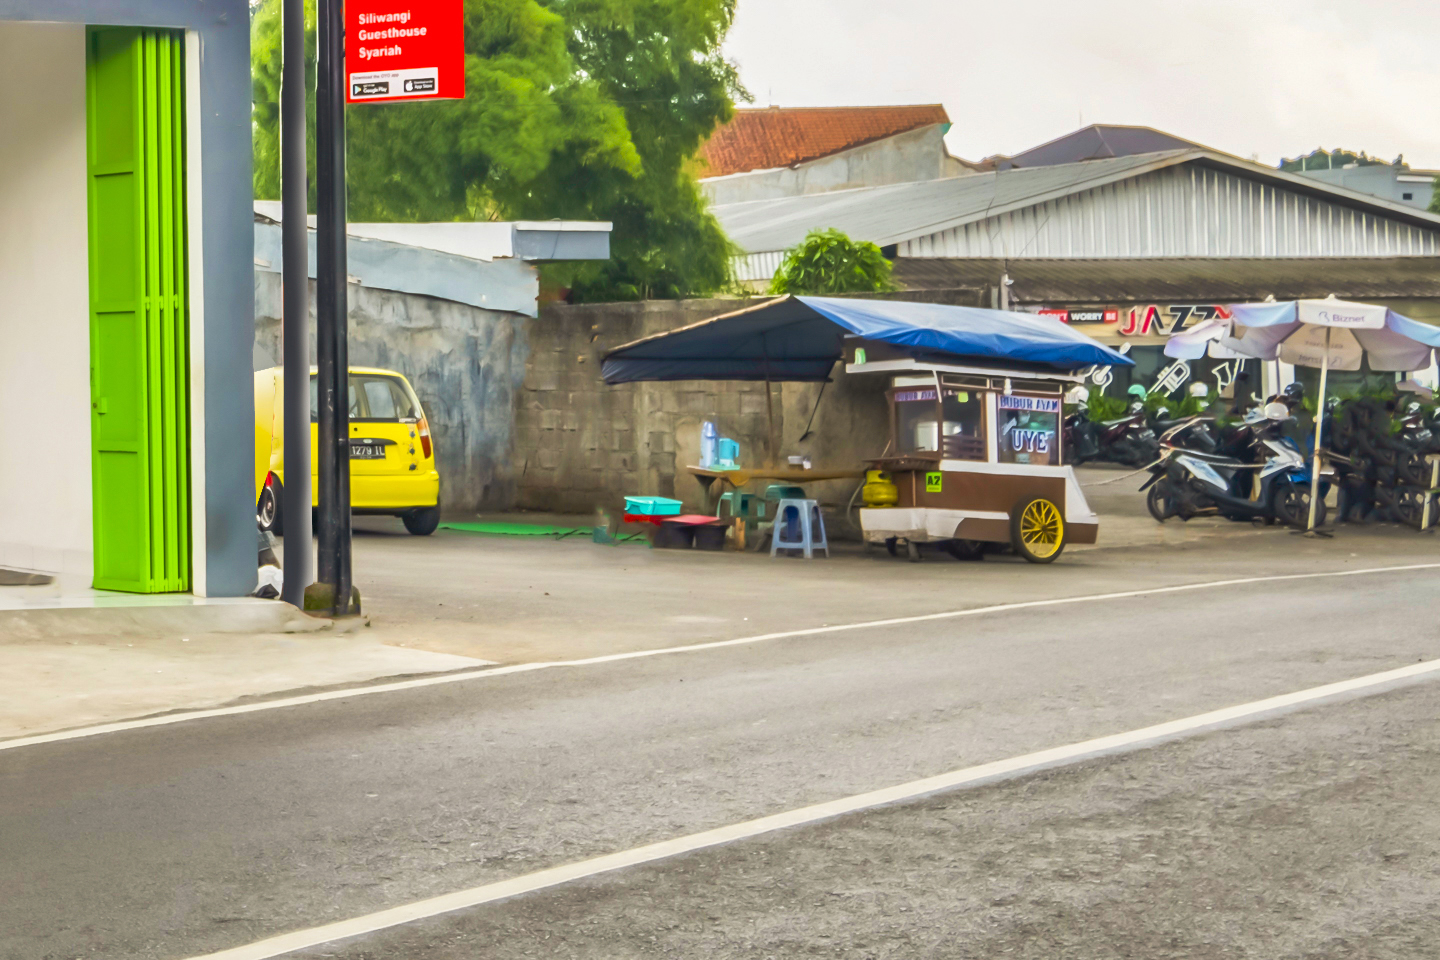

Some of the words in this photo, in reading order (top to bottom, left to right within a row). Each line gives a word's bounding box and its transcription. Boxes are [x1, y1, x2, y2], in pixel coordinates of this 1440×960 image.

[358, 10, 411, 25] Siliwangi
[358, 27, 428, 41] Guesthouse
[359, 45, 402, 60] Syariah
[1070, 312, 1103, 321] WORRY
[1105, 312, 1117, 321] BE
[1332, 313, 1365, 322] Biznet
[1000, 396, 1033, 409] BUBUR
[1012, 429, 1048, 453] UYE
[352, 446, 372, 455] 1279
[927, 475, 941, 486] A2
